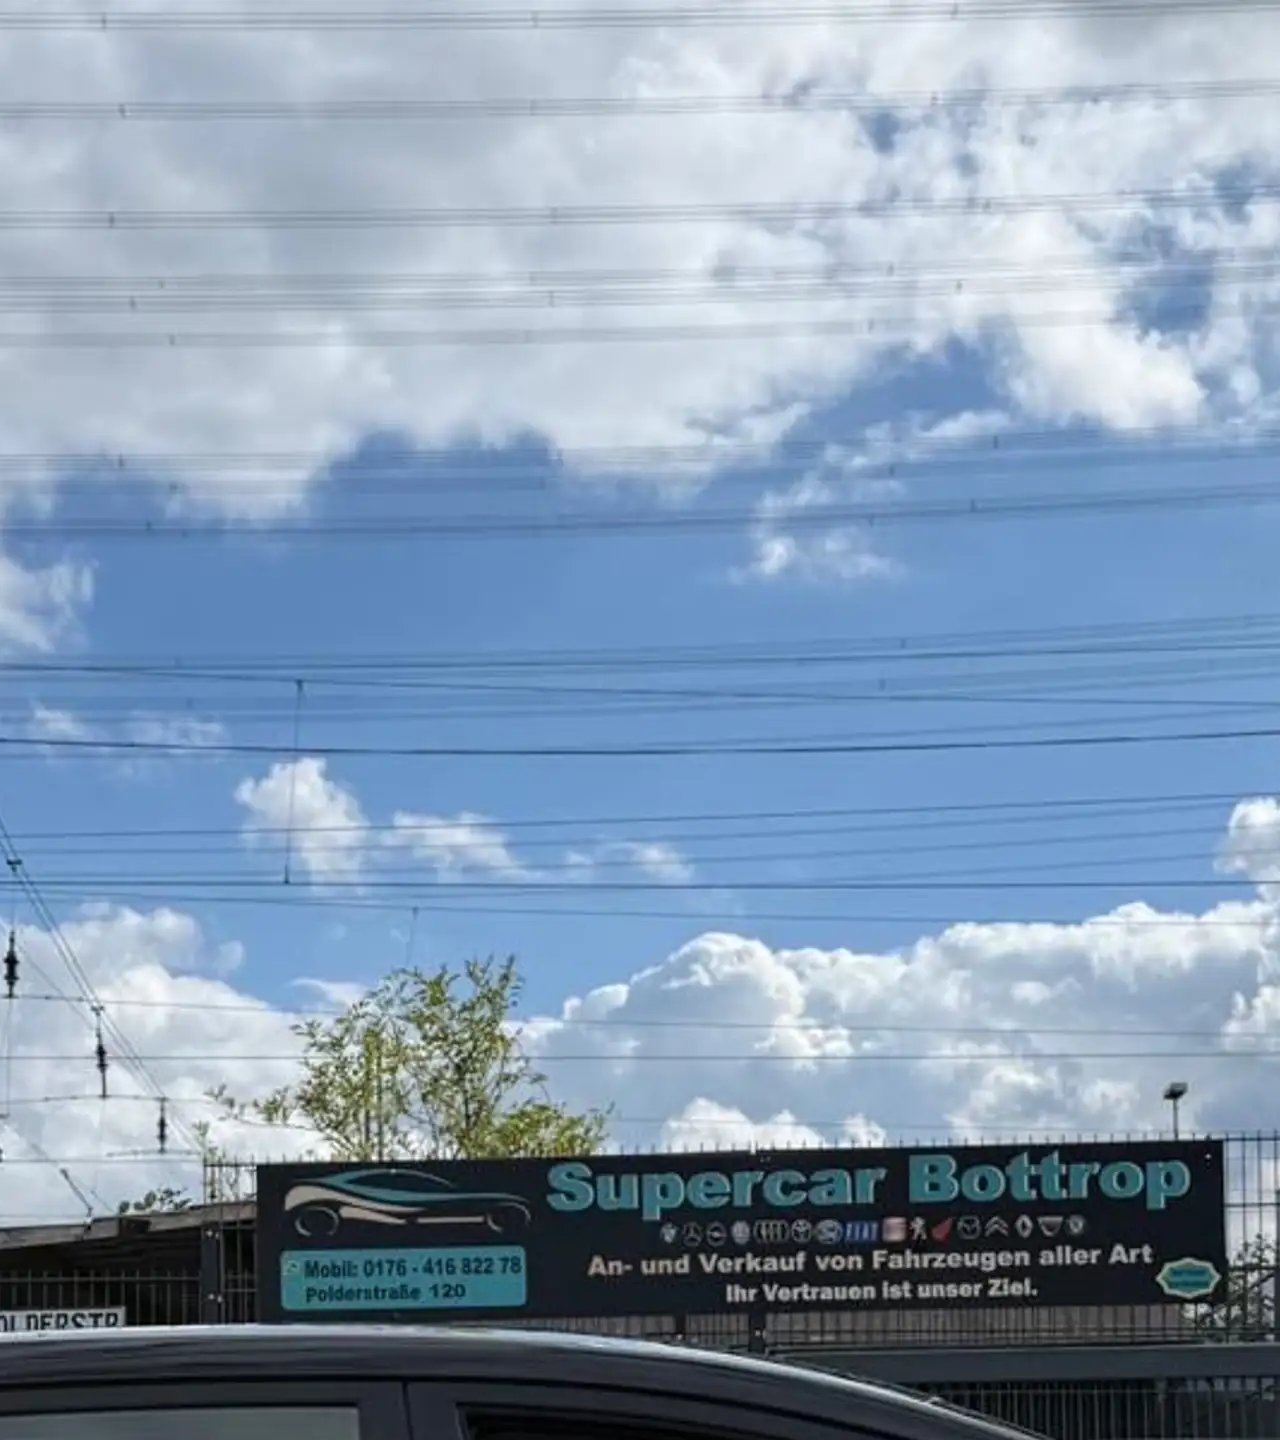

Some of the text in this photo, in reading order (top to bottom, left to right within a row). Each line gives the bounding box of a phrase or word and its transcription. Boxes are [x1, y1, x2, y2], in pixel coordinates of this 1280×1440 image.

[547, 1151, 1191, 1221] Supercar Bottrop
[304, 1260, 358, 1279] Mobil:
[363, 1258, 407, 1277] 0176
[423, 1257, 456, 1275] 416
[461, 1256, 494, 1274] 822
[499, 1255, 522, 1274] 78
[588, 1244, 1152, 1277] An- und Verkauf von Fahrzeugen aller Art
[428, 1283, 466, 1299] 120
[726, 1279, 1038, 1303] Ihr Vertrauen ist unser Ziel.
